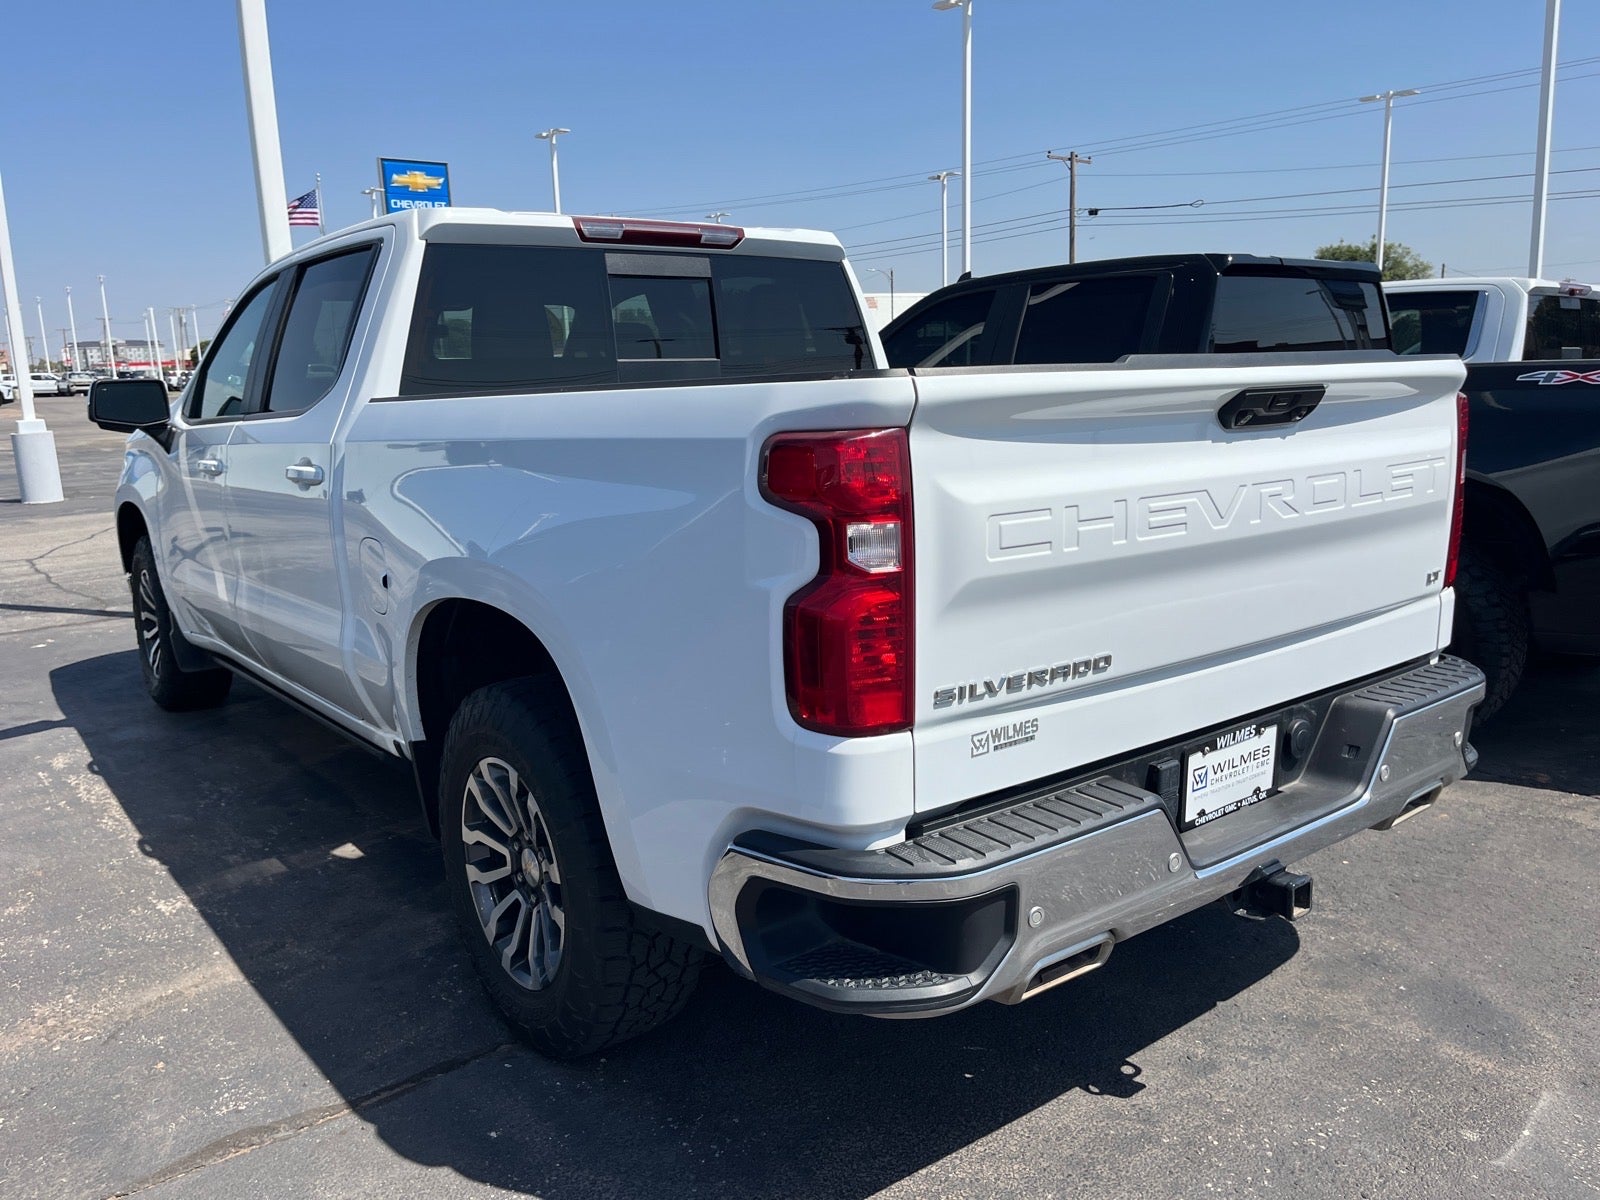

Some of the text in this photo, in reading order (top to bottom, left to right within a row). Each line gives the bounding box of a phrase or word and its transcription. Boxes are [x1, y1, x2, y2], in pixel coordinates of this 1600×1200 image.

[391, 199, 446, 209] CHEVROLET
[985, 456, 1446, 562] CHEVROLET
[1426, 570, 1441, 586] LT
[933, 652, 1113, 709] SILVERADO
[990, 717, 1039, 744] WILMES
[1216, 724, 1257, 750] WILMES
[1210, 758, 1270, 786] CHEVROLET GMC
[1212, 745, 1271, 775] WILMES
[1195, 808, 1224, 826] CHEVROLET
[1224, 803, 1237, 813] GMC
[1258, 791, 1267, 800] OK
